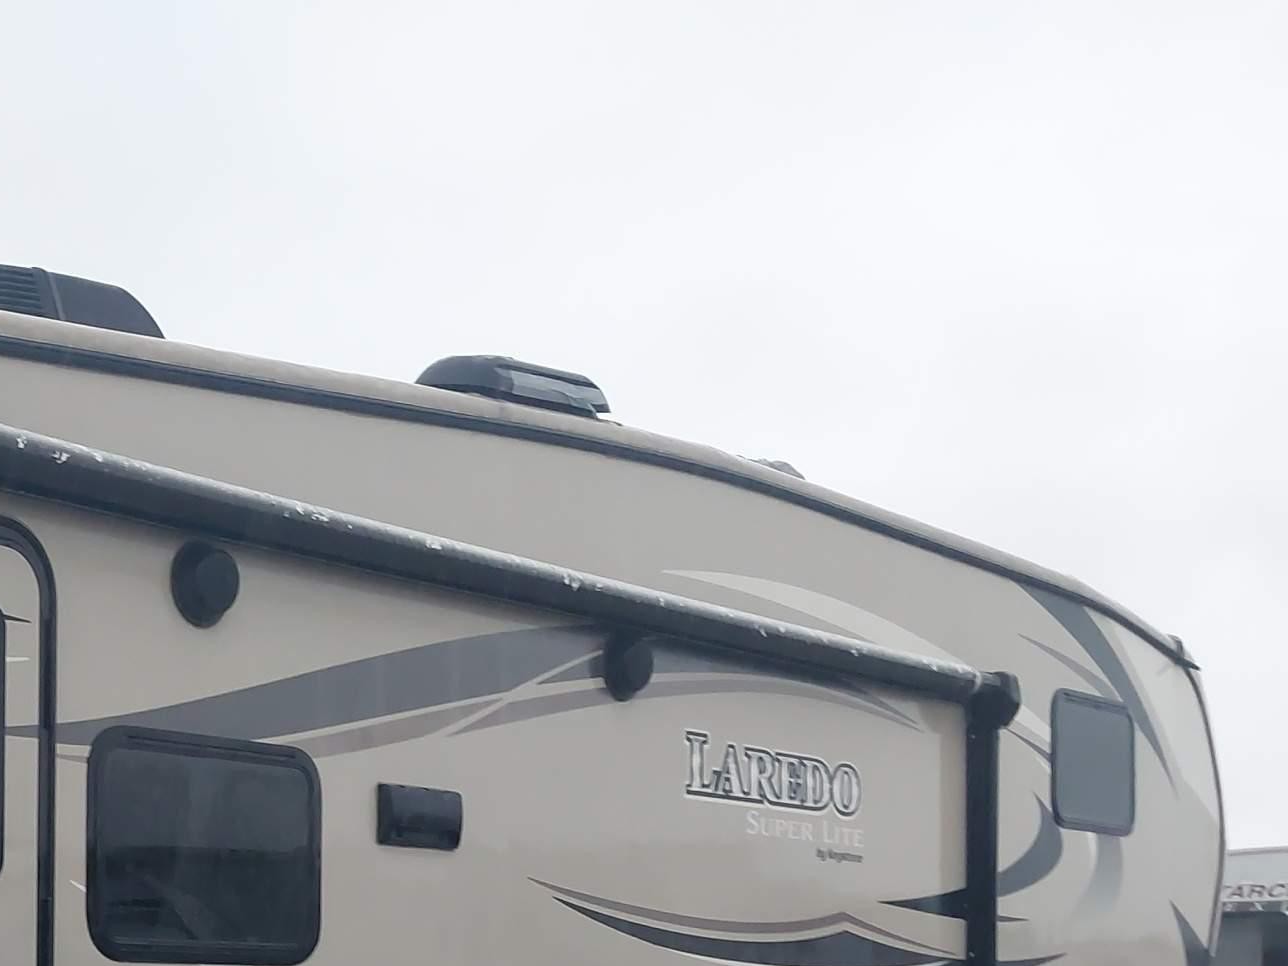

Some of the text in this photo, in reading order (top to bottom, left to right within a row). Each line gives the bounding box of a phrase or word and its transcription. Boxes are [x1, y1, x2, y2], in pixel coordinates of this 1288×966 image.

[684, 729, 861, 819] LAREDO
[746, 810, 864, 848] SUPER LITE
